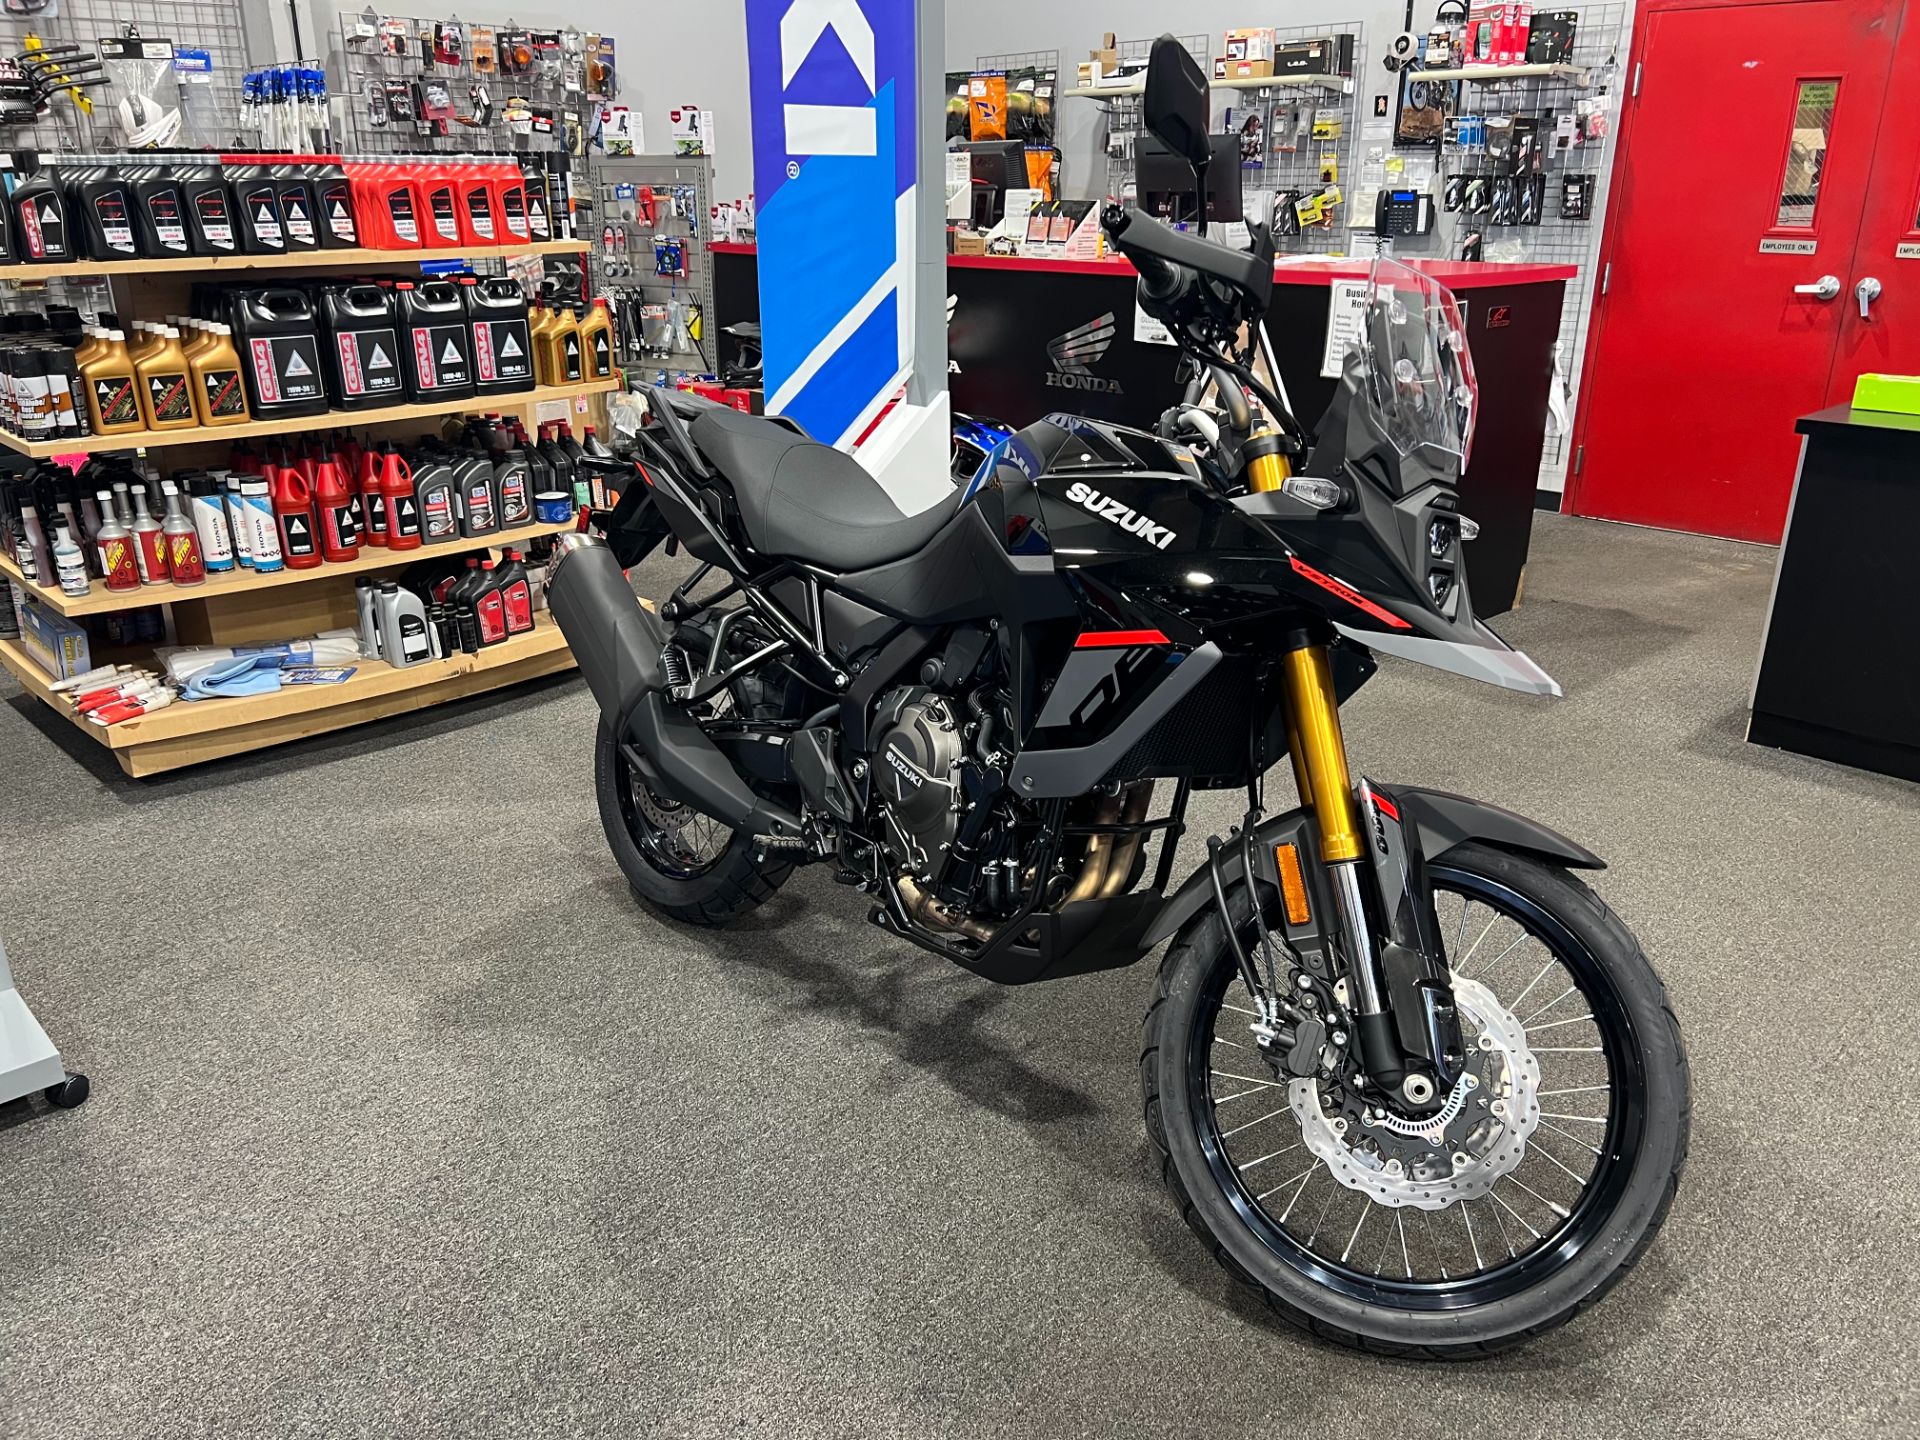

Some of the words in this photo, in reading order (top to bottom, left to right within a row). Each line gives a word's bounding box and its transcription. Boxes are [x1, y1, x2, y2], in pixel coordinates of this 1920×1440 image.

[24, 207, 41, 253] GN4
[1762, 242, 1795, 251] EMPLOYEES
[1797, 243, 1815, 251] ONLY
[341, 335, 360, 391] GN4
[415, 333, 432, 385] GN4
[476, 326, 493, 378] GN4
[254, 343, 273, 399] GN4
[1046, 372, 1125, 394] HONDA
[101, 386, 121, 409] HP4
[154, 383, 175, 406] HP4
[256, 518, 265, 549] HONDA
[1065, 482, 1177, 550] SUZUKI
[108, 542, 125, 573] NITRO
[174, 538, 191, 568] NITRO
[1297, 564, 1364, 605] V-STROM
[885, 751, 923, 788] SUZUKI
